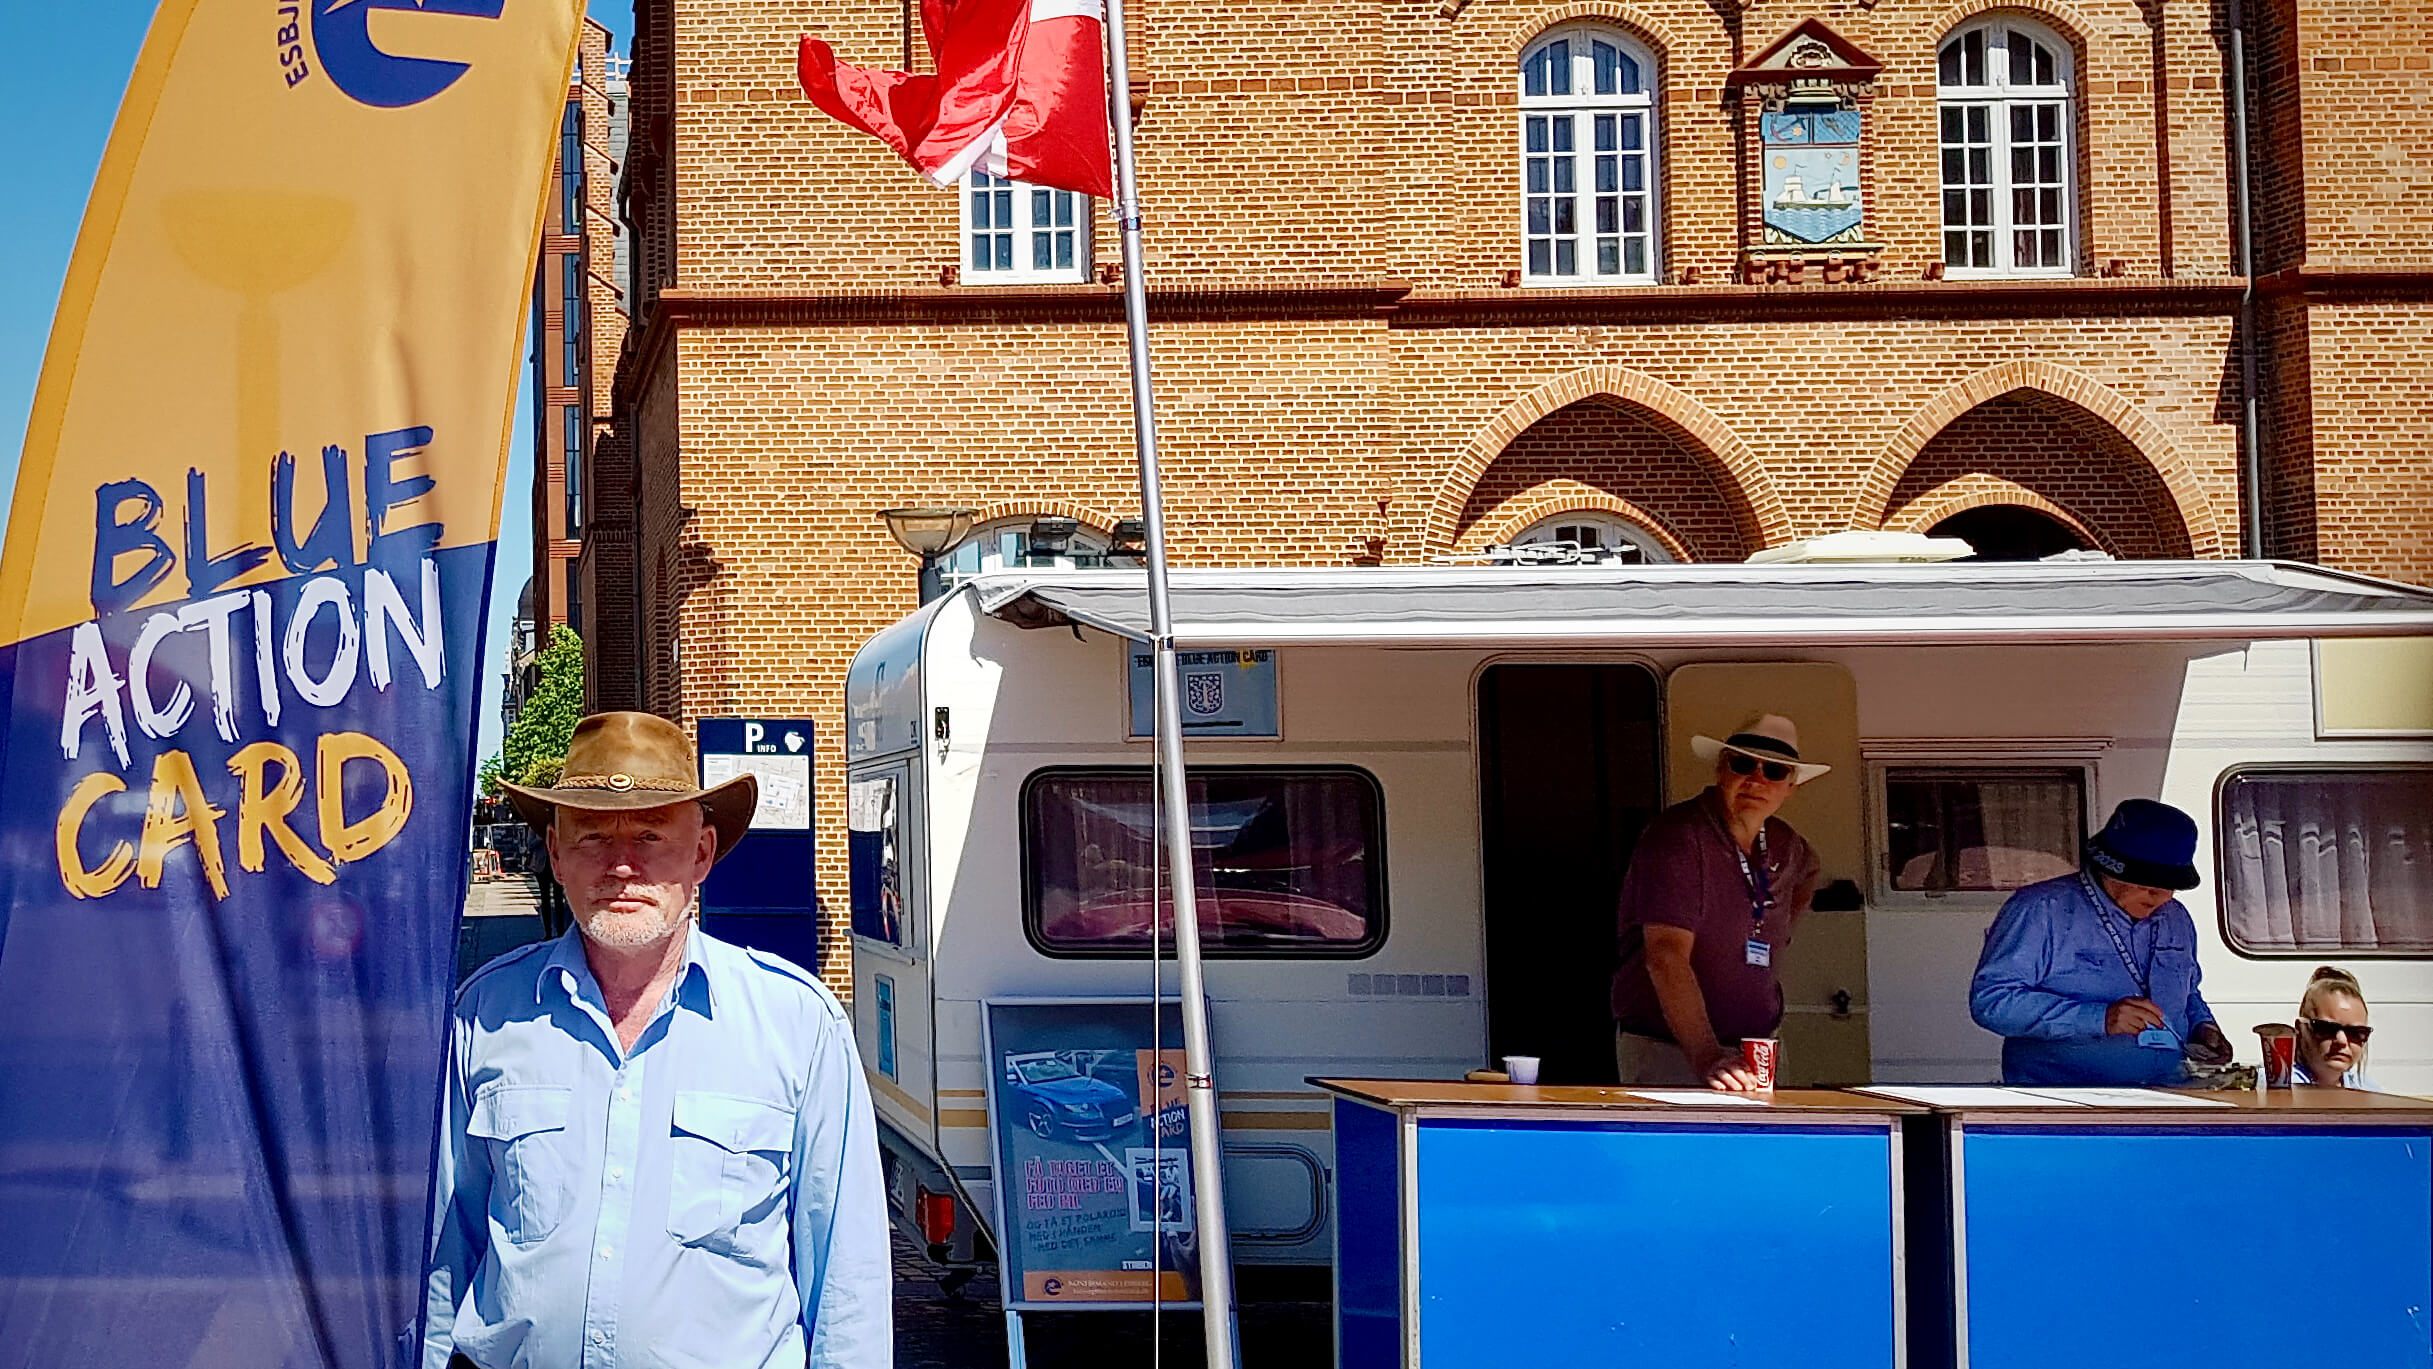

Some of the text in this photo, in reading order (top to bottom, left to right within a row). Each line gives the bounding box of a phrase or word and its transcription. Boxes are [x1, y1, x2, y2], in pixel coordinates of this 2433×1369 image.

[277, 0, 311, 89] ESBJ
[90, 425, 445, 617] BLUE
[60, 557, 447, 771] ACTION
[1207, 651, 1241, 665] ACTION
[1242, 650, 1269, 663] CARD
[745, 722, 777, 753] P INFO
[56, 730, 414, 903] CARD
[2092, 850, 2126, 874] 2023
[1026, 1177, 1064, 1193] FOTO
[1067, 1177, 1101, 1193] MED
